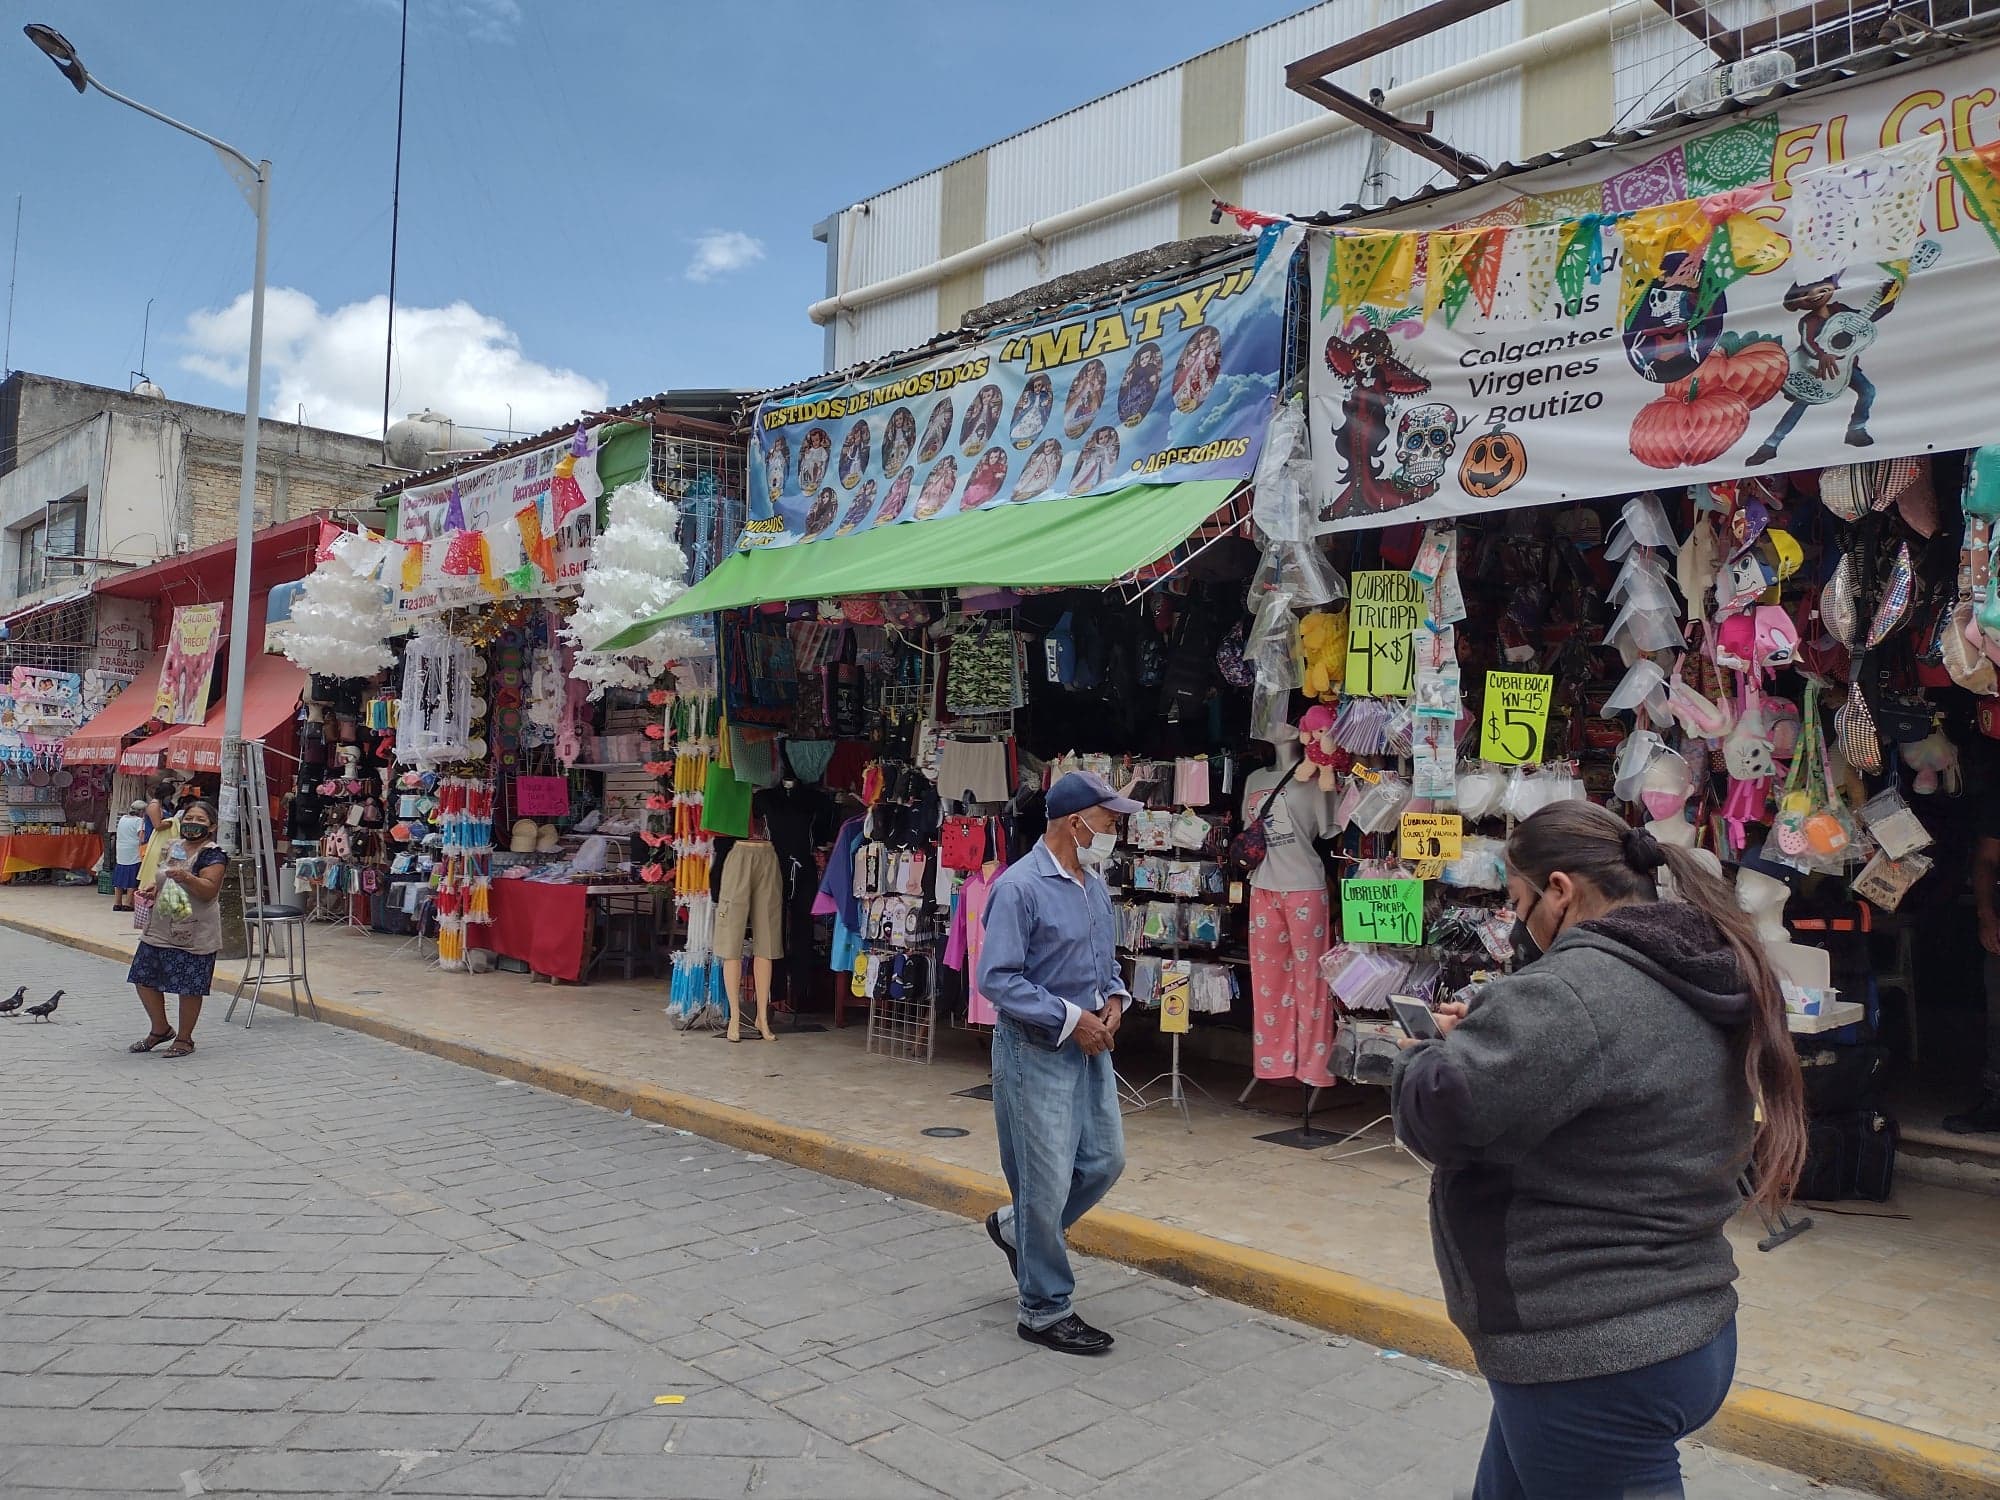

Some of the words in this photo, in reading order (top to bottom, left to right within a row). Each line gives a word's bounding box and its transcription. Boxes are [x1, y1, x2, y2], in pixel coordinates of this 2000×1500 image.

[1771, 115, 1848, 202] El
[1879, 87, 2000, 155] Gr
[1459, 327, 1613, 368] Colgantes
[1468, 357, 1600, 397] Virgenes
[763, 397, 849, 431] VESTIDOS
[847, 389, 871, 416] DE
[1455, 414, 1479, 435] y
[1484, 390, 1603, 426] Bautizo
[1357, 572, 1424, 604] CUBREBOC
[182, 613, 212, 624] CALIDAD
[1355, 604, 1417, 630] TRICAPA
[99, 656, 145, 669] TRABAJOS
[117, 649, 131, 658] DE
[1489, 673, 1549, 692] CUBREBOCA
[1501, 692, 1543, 710] KN-95
[1368, 900, 1408, 913] TRICAPA
